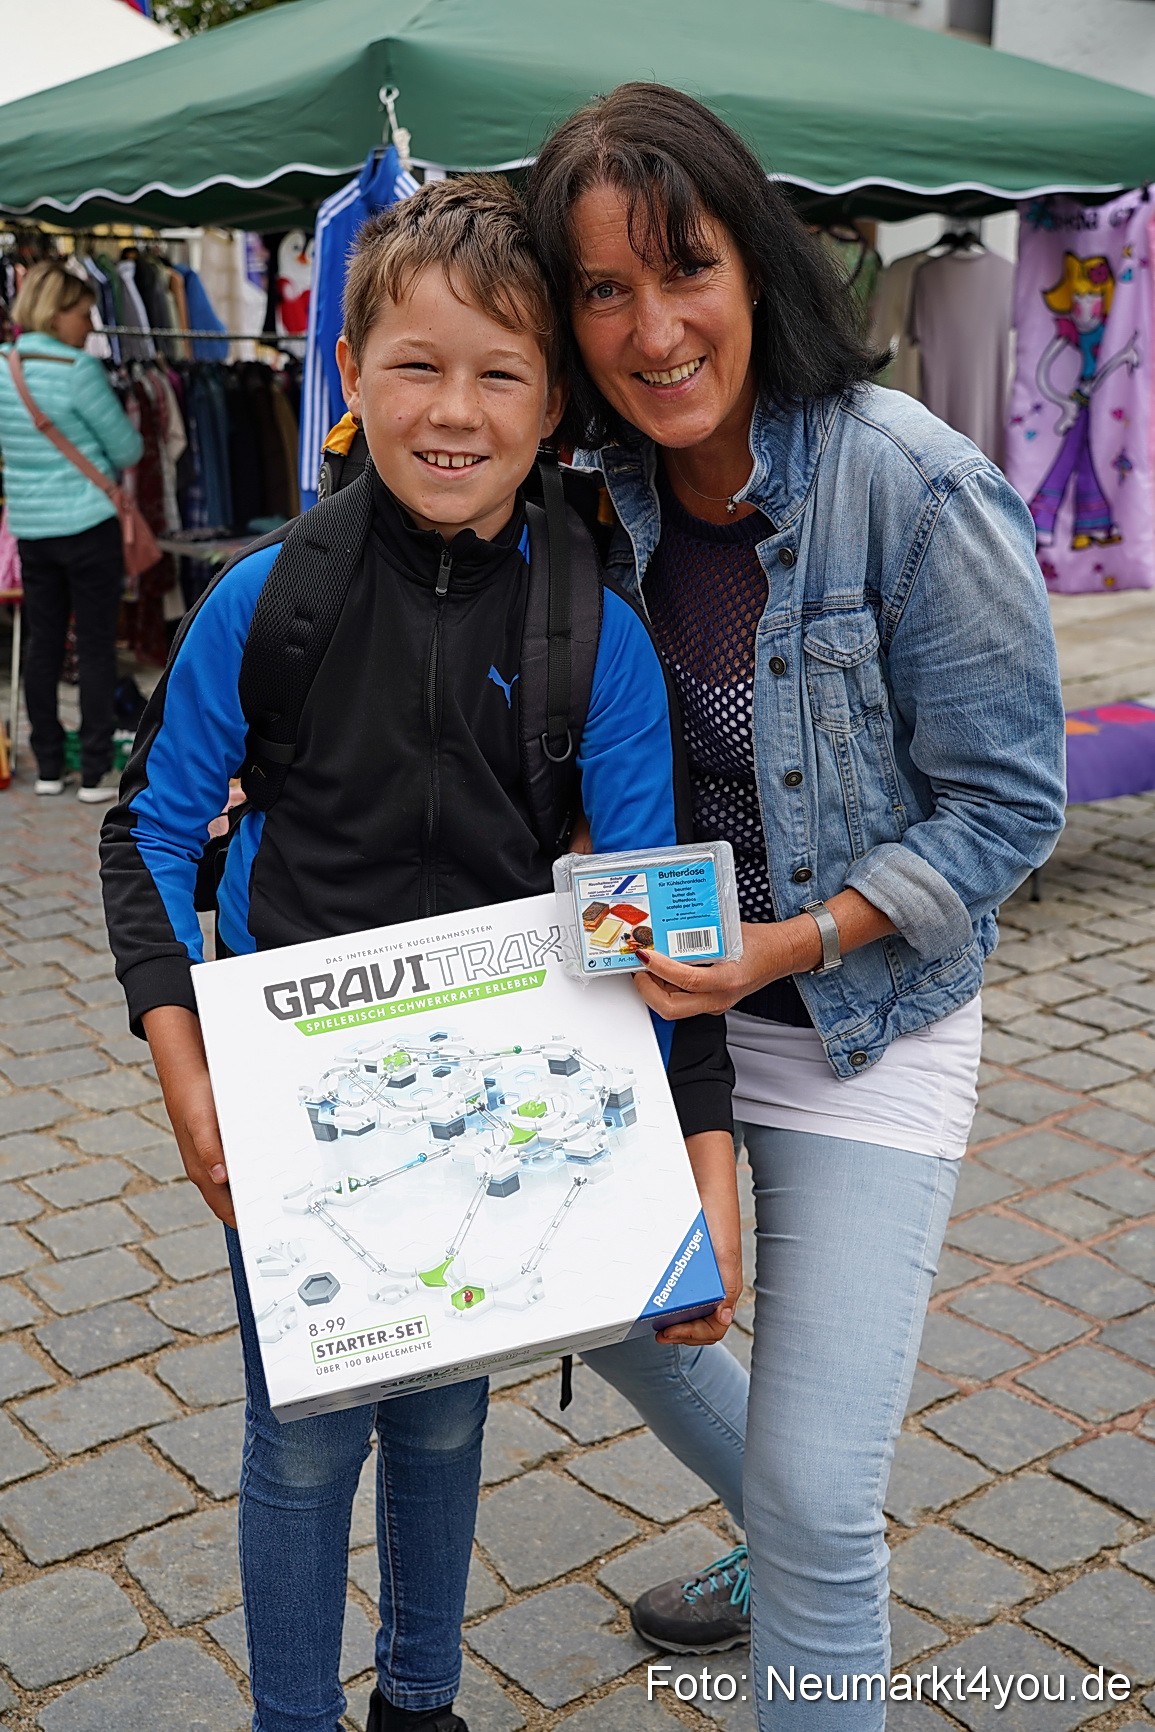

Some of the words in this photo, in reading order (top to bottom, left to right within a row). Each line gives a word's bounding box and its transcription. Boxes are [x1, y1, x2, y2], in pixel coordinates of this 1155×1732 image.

[658, 867, 705, 879] Butterdose
[325, 955, 344, 965] DAS
[346, 942, 404, 960] INTERAKTIVE
[406, 924, 493, 948] KUGELBAHNSYSTEM
[263, 925, 564, 1021] GRAVITRAX
[306, 1007, 386, 1032] SPIELERISCH
[390, 987, 481, 1014] SCHWERKRAFT
[485, 975, 539, 994] ERLEBEN
[652, 1228, 704, 1308] Ravensburger
[308, 1316, 346, 1337] 8-99
[316, 1321, 423, 1358] STARTER-SET
[315, 1363, 341, 1376] ÜBER
[344, 1358, 362, 1369] 100
[365, 1340, 433, 1364] BAUELEMENTE
